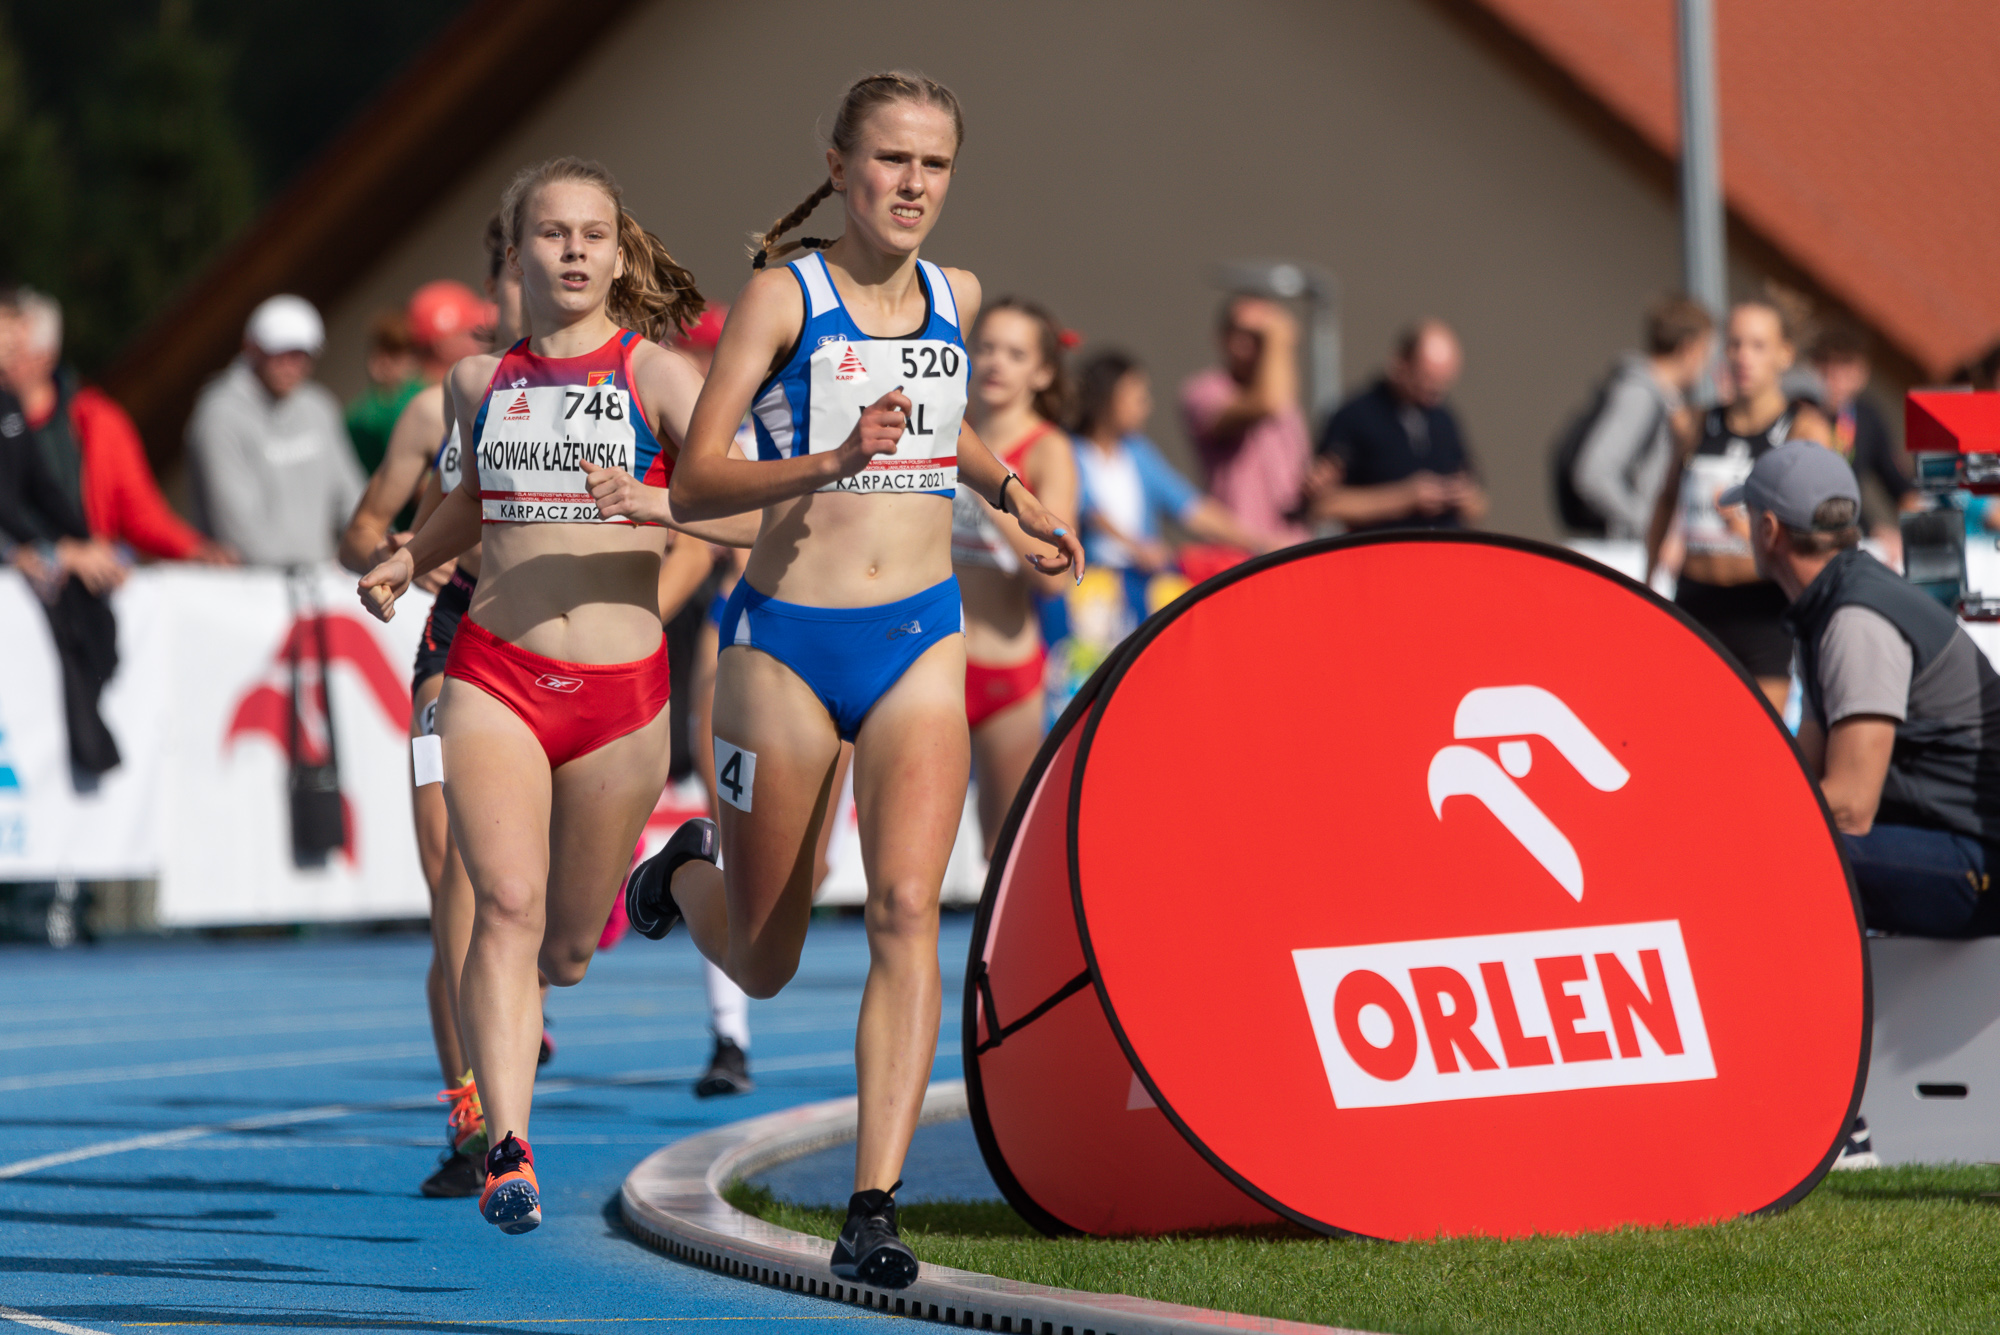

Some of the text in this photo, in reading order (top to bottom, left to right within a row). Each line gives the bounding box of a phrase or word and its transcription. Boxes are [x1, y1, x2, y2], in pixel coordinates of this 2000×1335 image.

[902, 346, 960, 379] 520
[564, 391, 624, 421] 748
[483, 434, 628, 472] NOWAK ŁAŻEWSKA
[836, 472, 945, 489] KARPACZ 2021
[500, 504, 600, 520] KARPACZ 202
[720, 750, 743, 803] 4
[1333, 948, 1686, 1082] ORLEN
